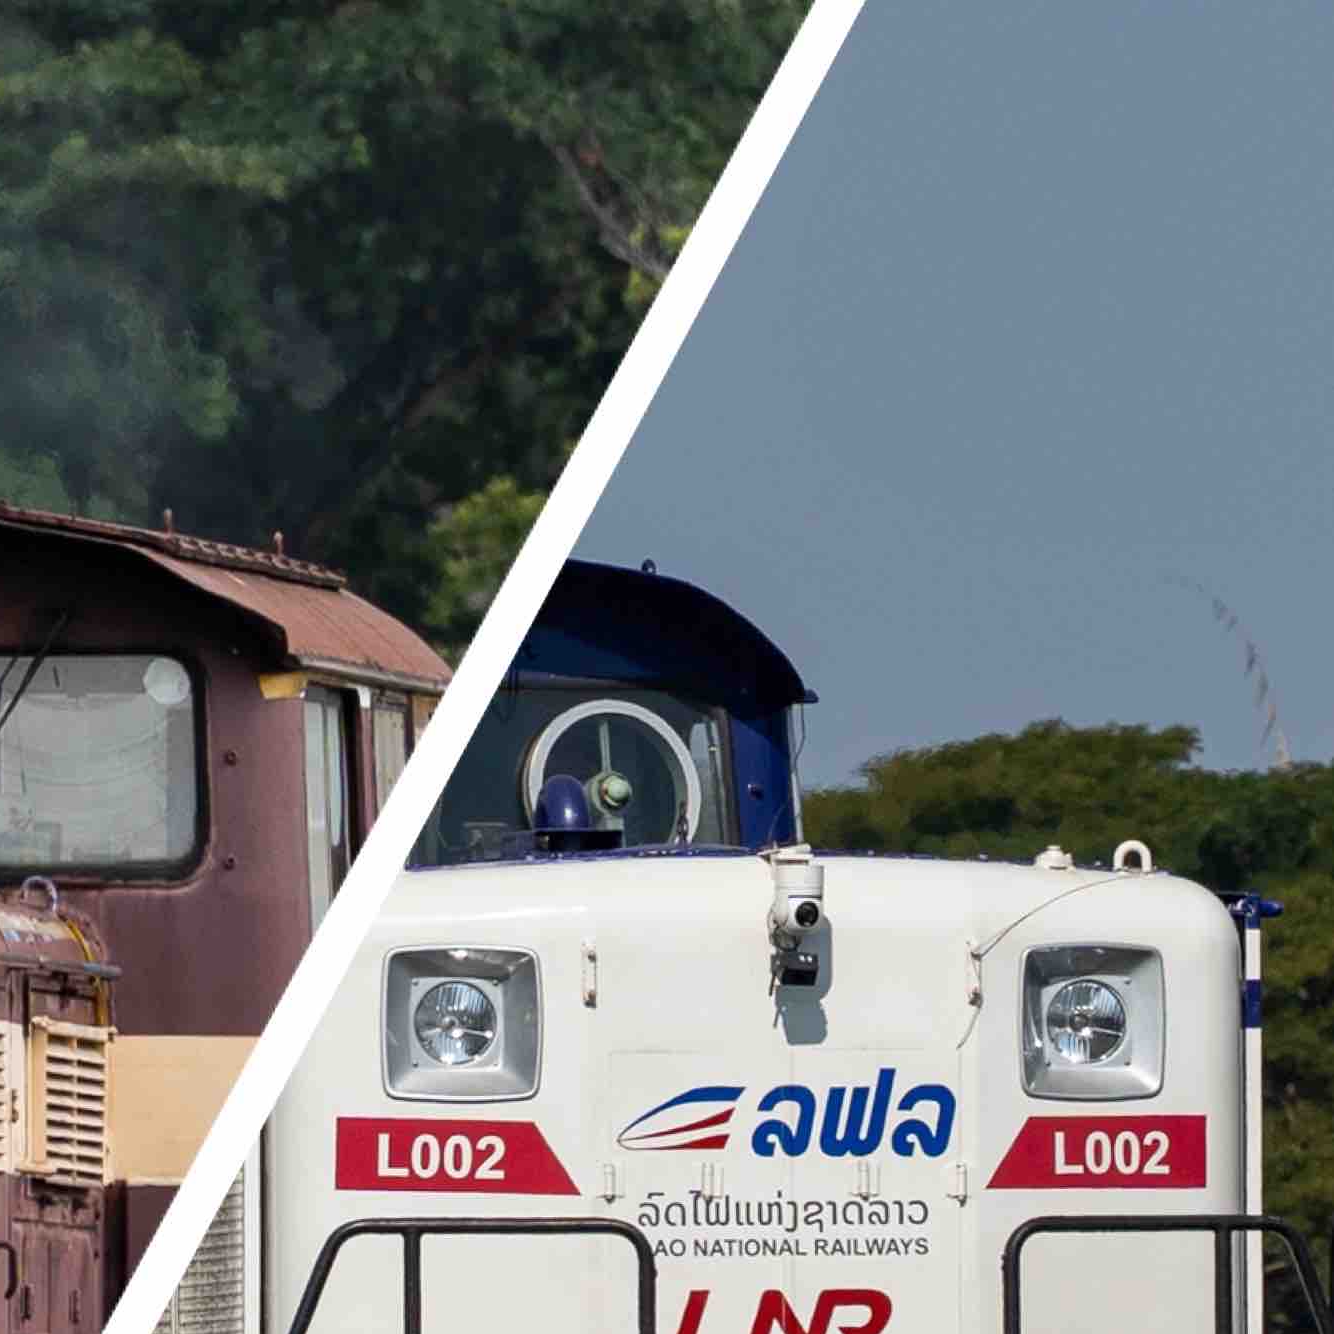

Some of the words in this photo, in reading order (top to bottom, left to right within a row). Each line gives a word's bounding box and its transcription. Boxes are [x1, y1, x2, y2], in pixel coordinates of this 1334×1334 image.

[377, 1132, 506, 1180] L002
[1054, 1130, 1171, 1175] L002
[647, 1238, 688, 1257] AO
[693, 1238, 808, 1257] NATIONAL
[814, 1237, 930, 1257] RAILWAYS
